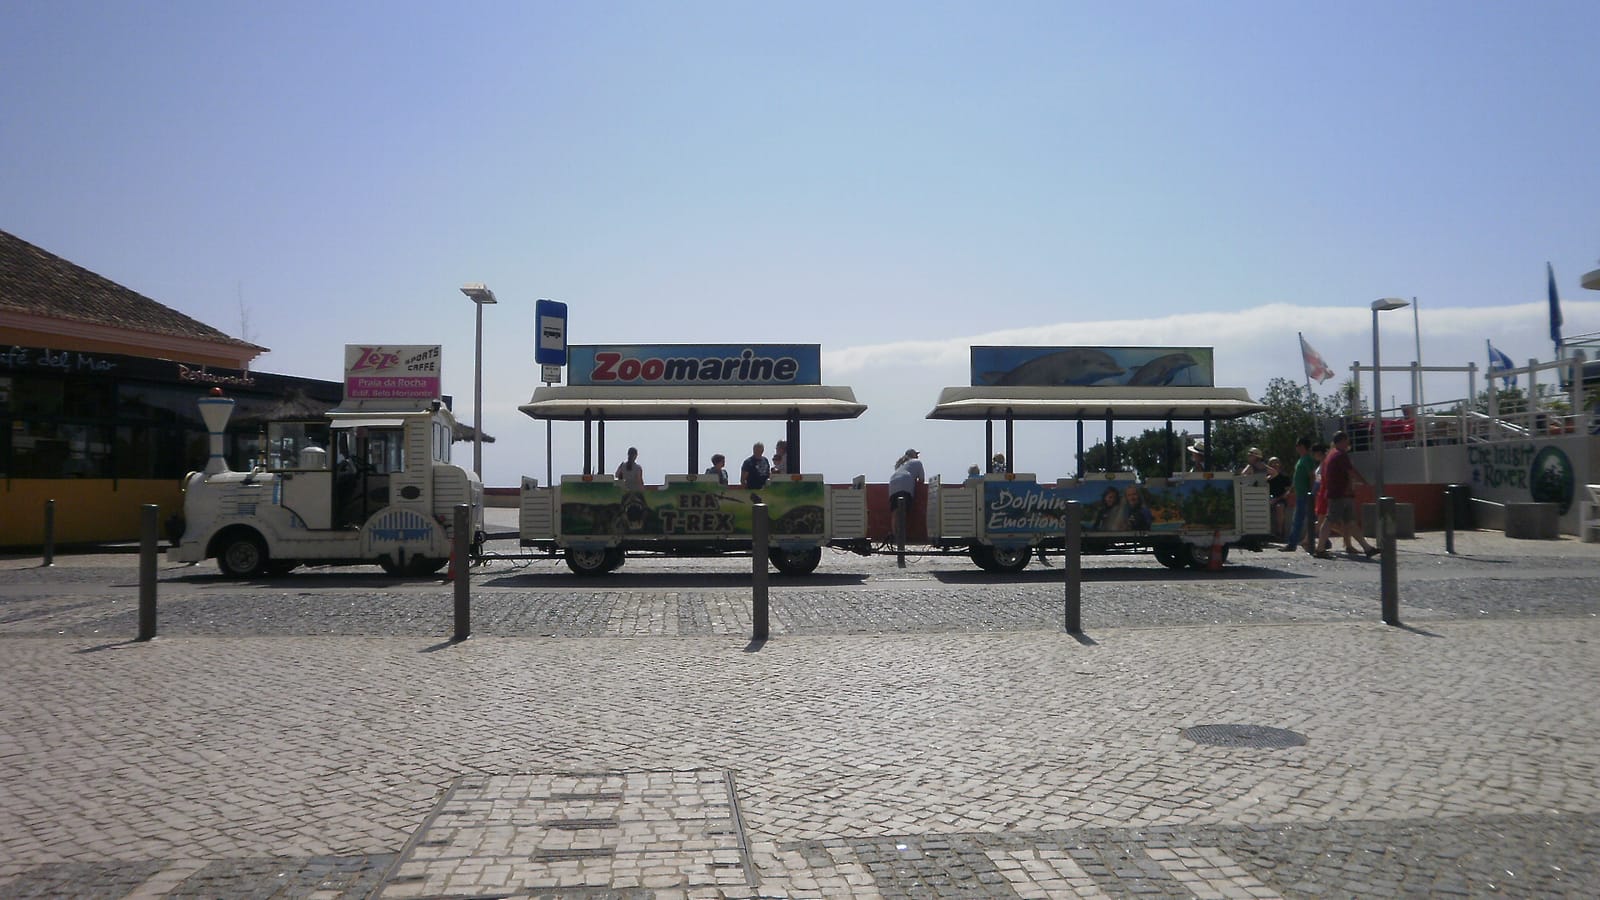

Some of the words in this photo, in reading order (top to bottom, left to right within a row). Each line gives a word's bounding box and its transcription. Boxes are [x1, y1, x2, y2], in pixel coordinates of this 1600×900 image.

[36, 348, 71, 369] del
[78, 353, 117, 371] Mar
[405, 347, 439, 365] SPORTS
[590, 348, 799, 382] Zoomarine
[358, 378, 382, 387] Praia
[383, 378, 396, 387] da
[398, 378, 427, 387] Rocha
[372, 390, 390, 398] Belo
[392, 390, 433, 398] Horizonte
[678, 492, 719, 510] ERA
[991, 488, 1066, 513] Dolphin
[659, 510, 735, 533] T-REX
